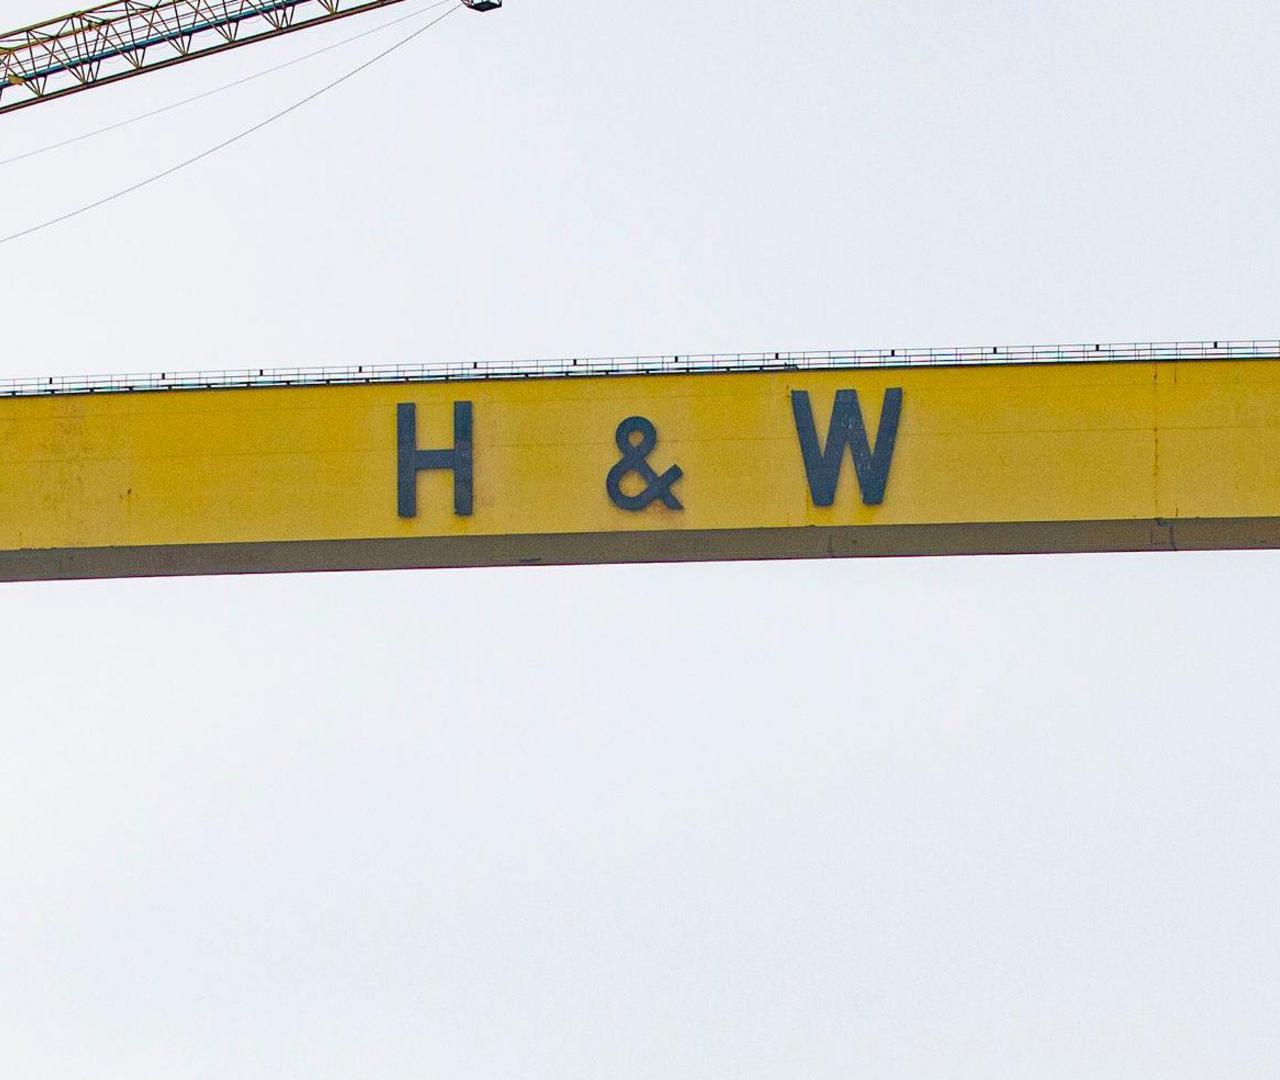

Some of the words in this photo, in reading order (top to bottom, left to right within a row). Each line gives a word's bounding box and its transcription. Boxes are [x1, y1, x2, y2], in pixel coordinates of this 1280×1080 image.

[396, 400, 473, 518] H
[606, 416, 684, 511] &
[791, 387, 903, 507] W
